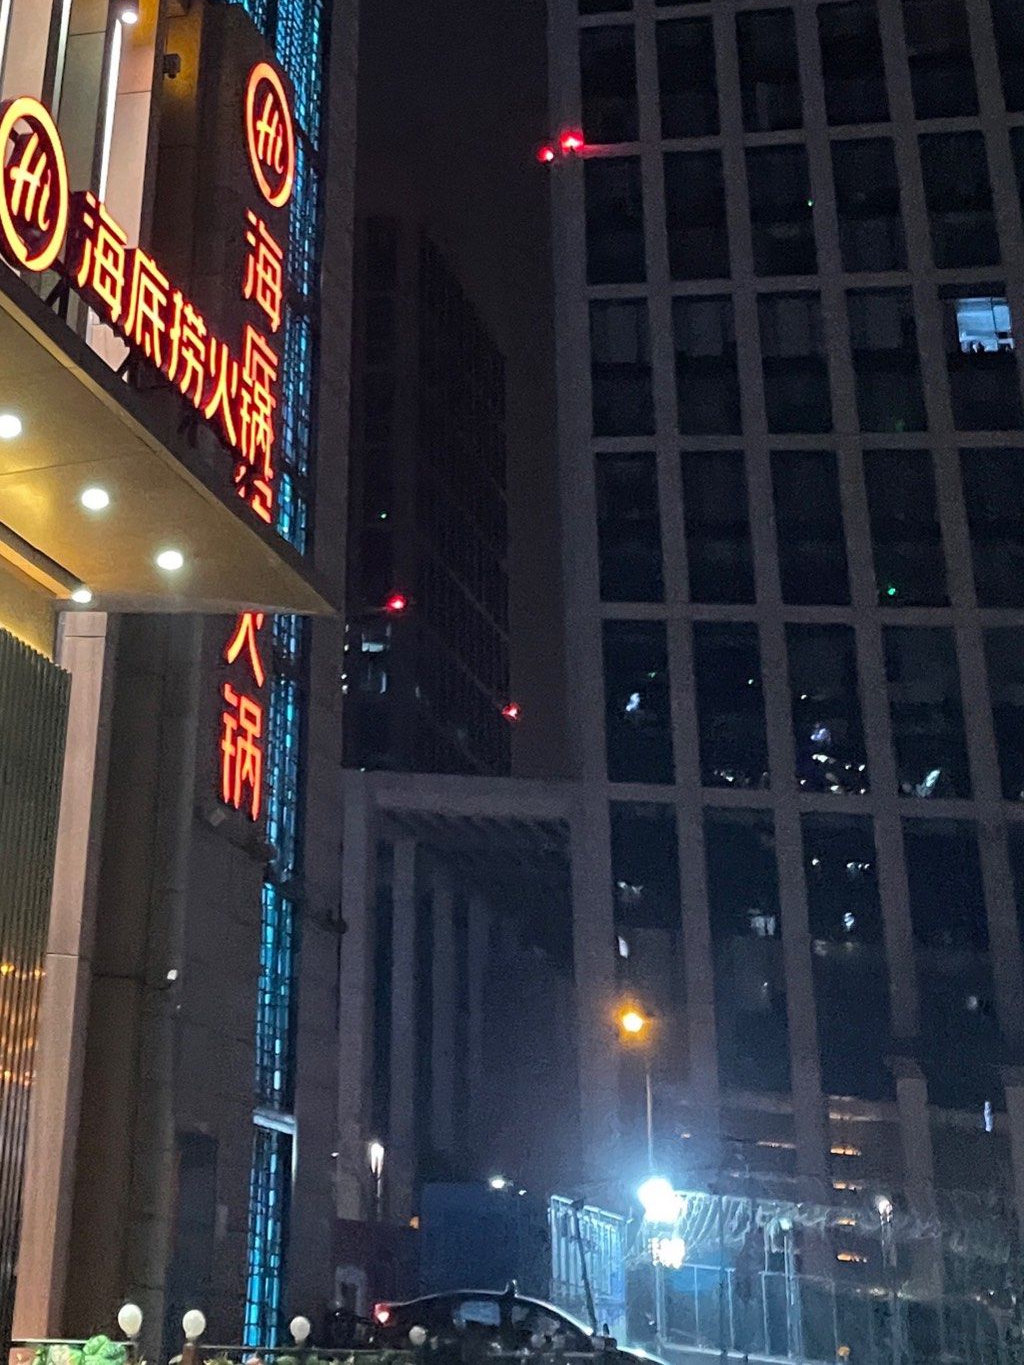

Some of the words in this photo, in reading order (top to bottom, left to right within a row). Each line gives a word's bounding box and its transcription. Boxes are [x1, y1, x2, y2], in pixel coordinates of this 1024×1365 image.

[9, 132, 52, 232] Hi
[77, 191, 272, 481] 海底捞火锅
